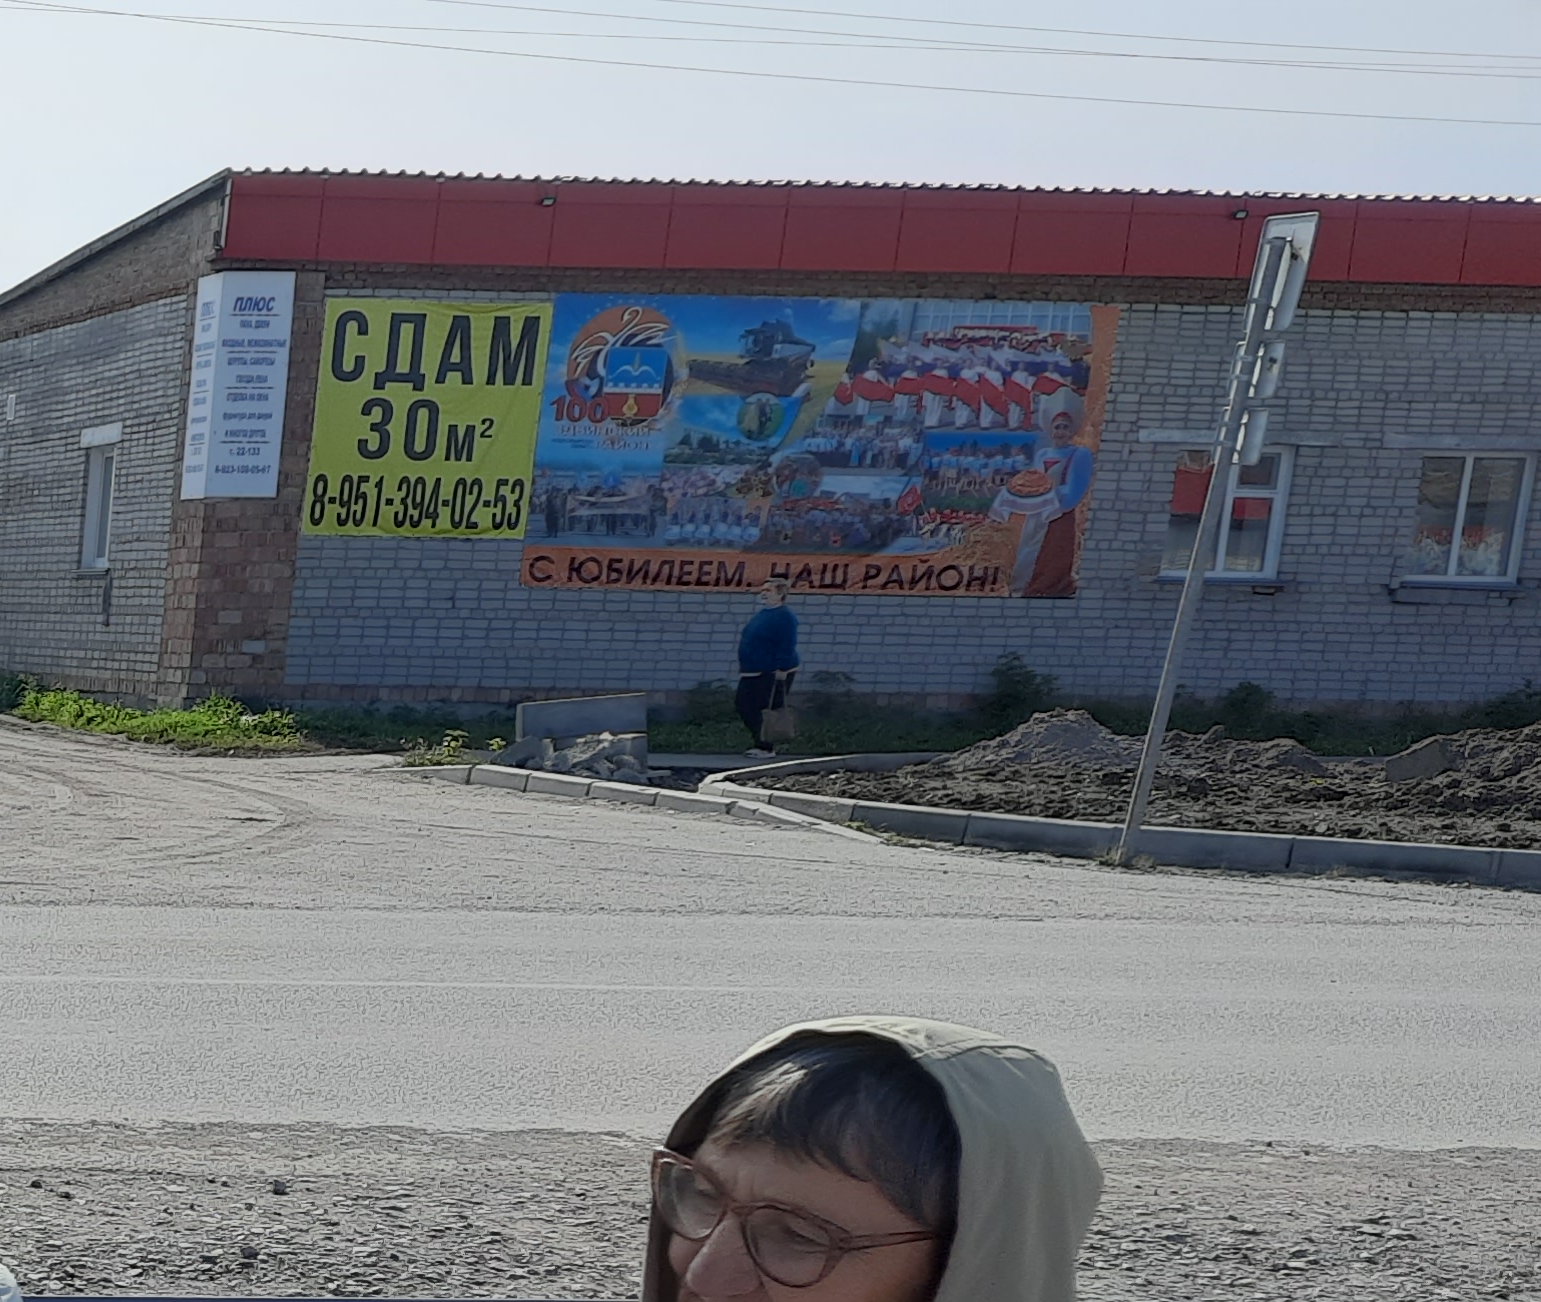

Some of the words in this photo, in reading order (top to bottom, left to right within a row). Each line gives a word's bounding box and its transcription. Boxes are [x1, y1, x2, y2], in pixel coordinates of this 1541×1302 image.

[233, 296, 276, 312] ПЛЮС
[331, 310, 541, 391] СДАМ
[550, 395, 610, 424] 100
[309, 473, 525, 530] 8-951-394-02-53
[528, 555, 556, 583] С
[861, 559, 999, 592] РАЙОН!
